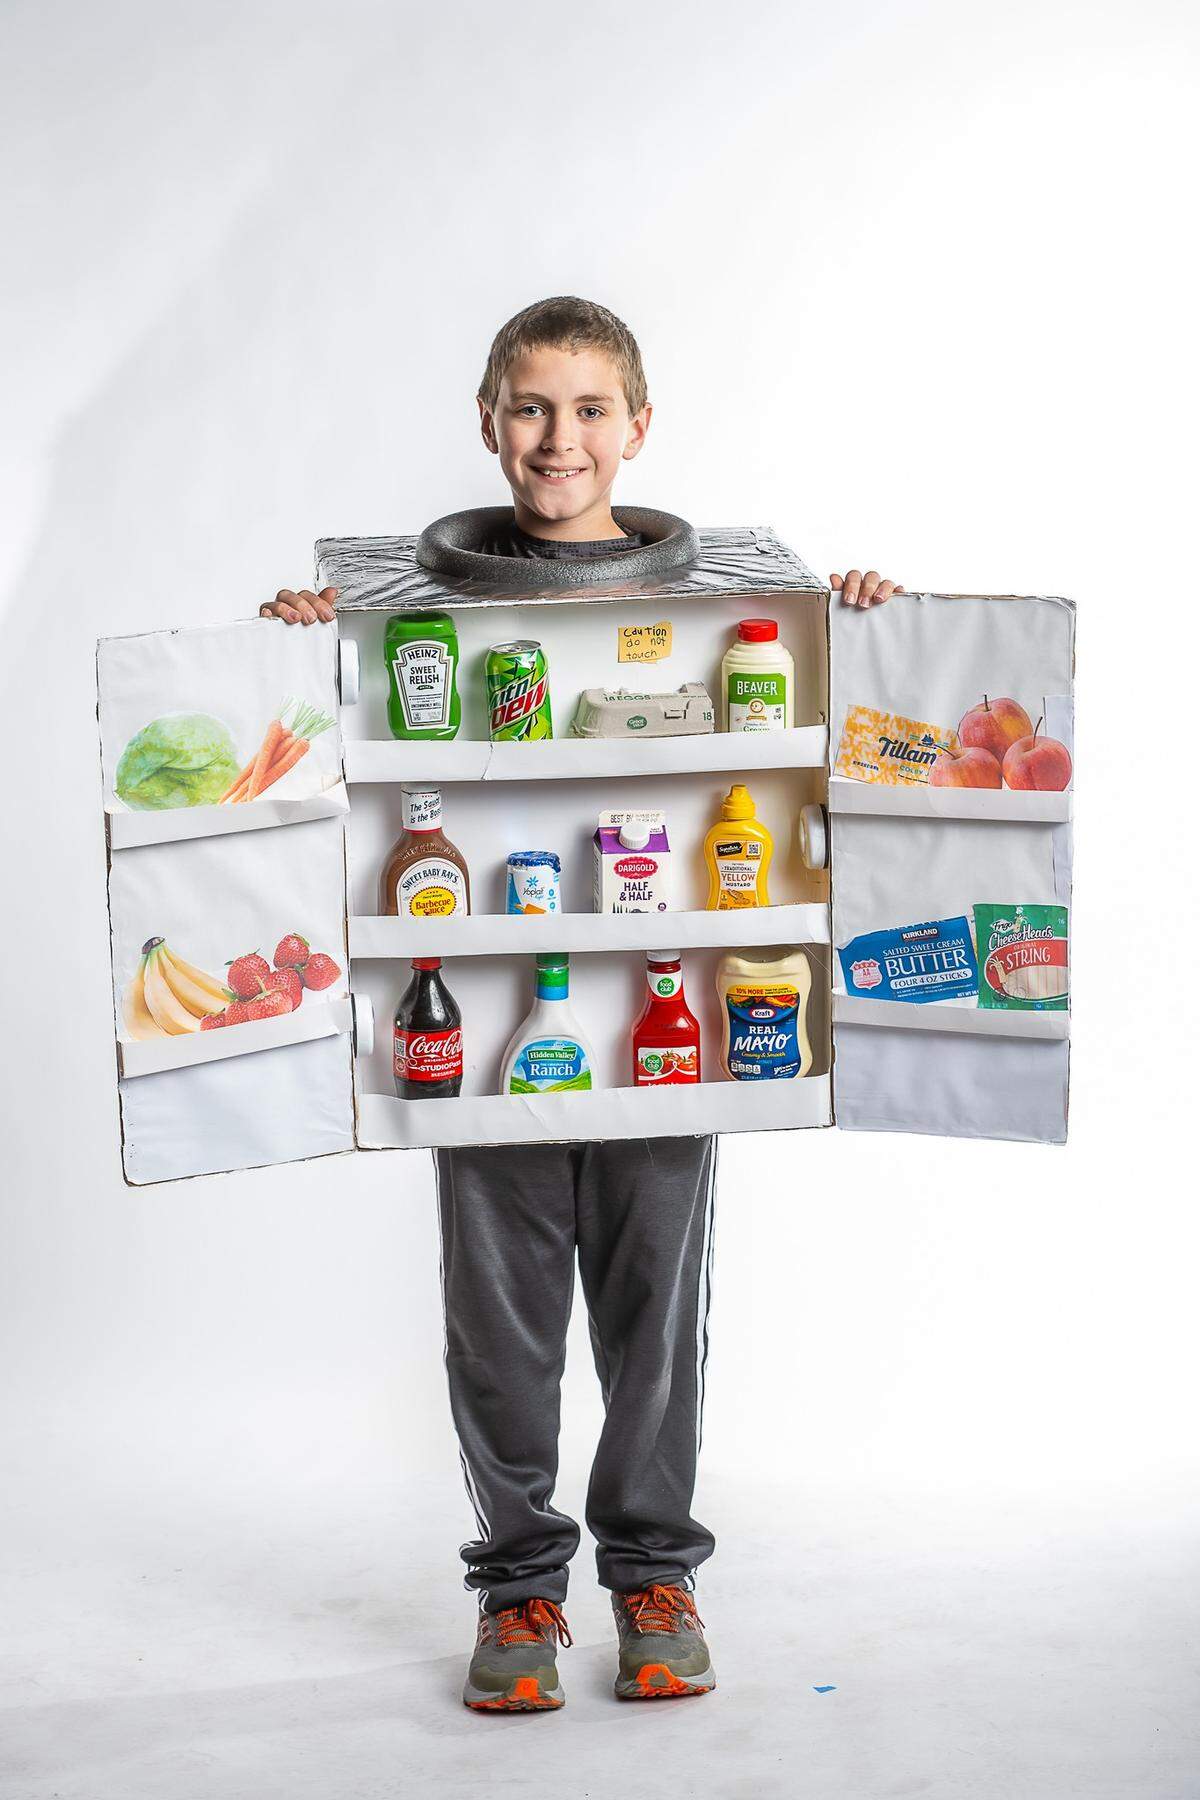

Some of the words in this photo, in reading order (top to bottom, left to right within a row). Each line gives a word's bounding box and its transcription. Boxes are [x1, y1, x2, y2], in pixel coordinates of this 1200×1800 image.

[626, 638, 640, 647] do
[651, 637, 666, 646] not
[407, 649, 438, 660] HEINZ
[626, 650, 657, 660] touch
[410, 665, 436, 675] SWEET
[409, 674, 439, 684] RELISH
[737, 681, 777, 695] BEAVER
[702, 712, 712, 720] 18
[900, 764, 924, 775] COLBY
[410, 804, 422, 812] The
[410, 815, 416, 823] is
[417, 813, 428, 822] the
[611, 814, 624, 823] BEST
[618, 864, 654, 872] DARIGOLD
[402, 872, 422, 891] SWEET
[423, 868, 441, 877] BABY
[441, 869, 459, 883] RAY'S
[624, 881, 648, 891] HALF
[523, 887, 545, 897] Yoplait
[619, 891, 626, 901] &
[628, 891, 653, 901] HALF
[415, 898, 450, 910] Barbecue
[424, 906, 445, 915] Sauce
[993, 921, 1012, 931] Frigo
[902, 928, 938, 940] KIRKLAND
[883, 946, 910, 956] SALTED
[911, 942, 936, 953] SWEET
[936, 938, 965, 949] CREAM
[885, 949, 969, 977] BUTTER
[1006, 946, 1050, 970] STRING
[894, 977, 918, 988] FOUR
[926, 974, 938, 983] OZ
[939, 970, 968, 981] STICKS
[749, 1026, 778, 1034] REAL
[734, 1033, 793, 1052] MAYO
[529, 1051, 554, 1059] Hidden
[555, 1052, 575, 1060] Valley
[742, 1051, 761, 1059] Creamy
[530, 1063, 573, 1076] Ranch
